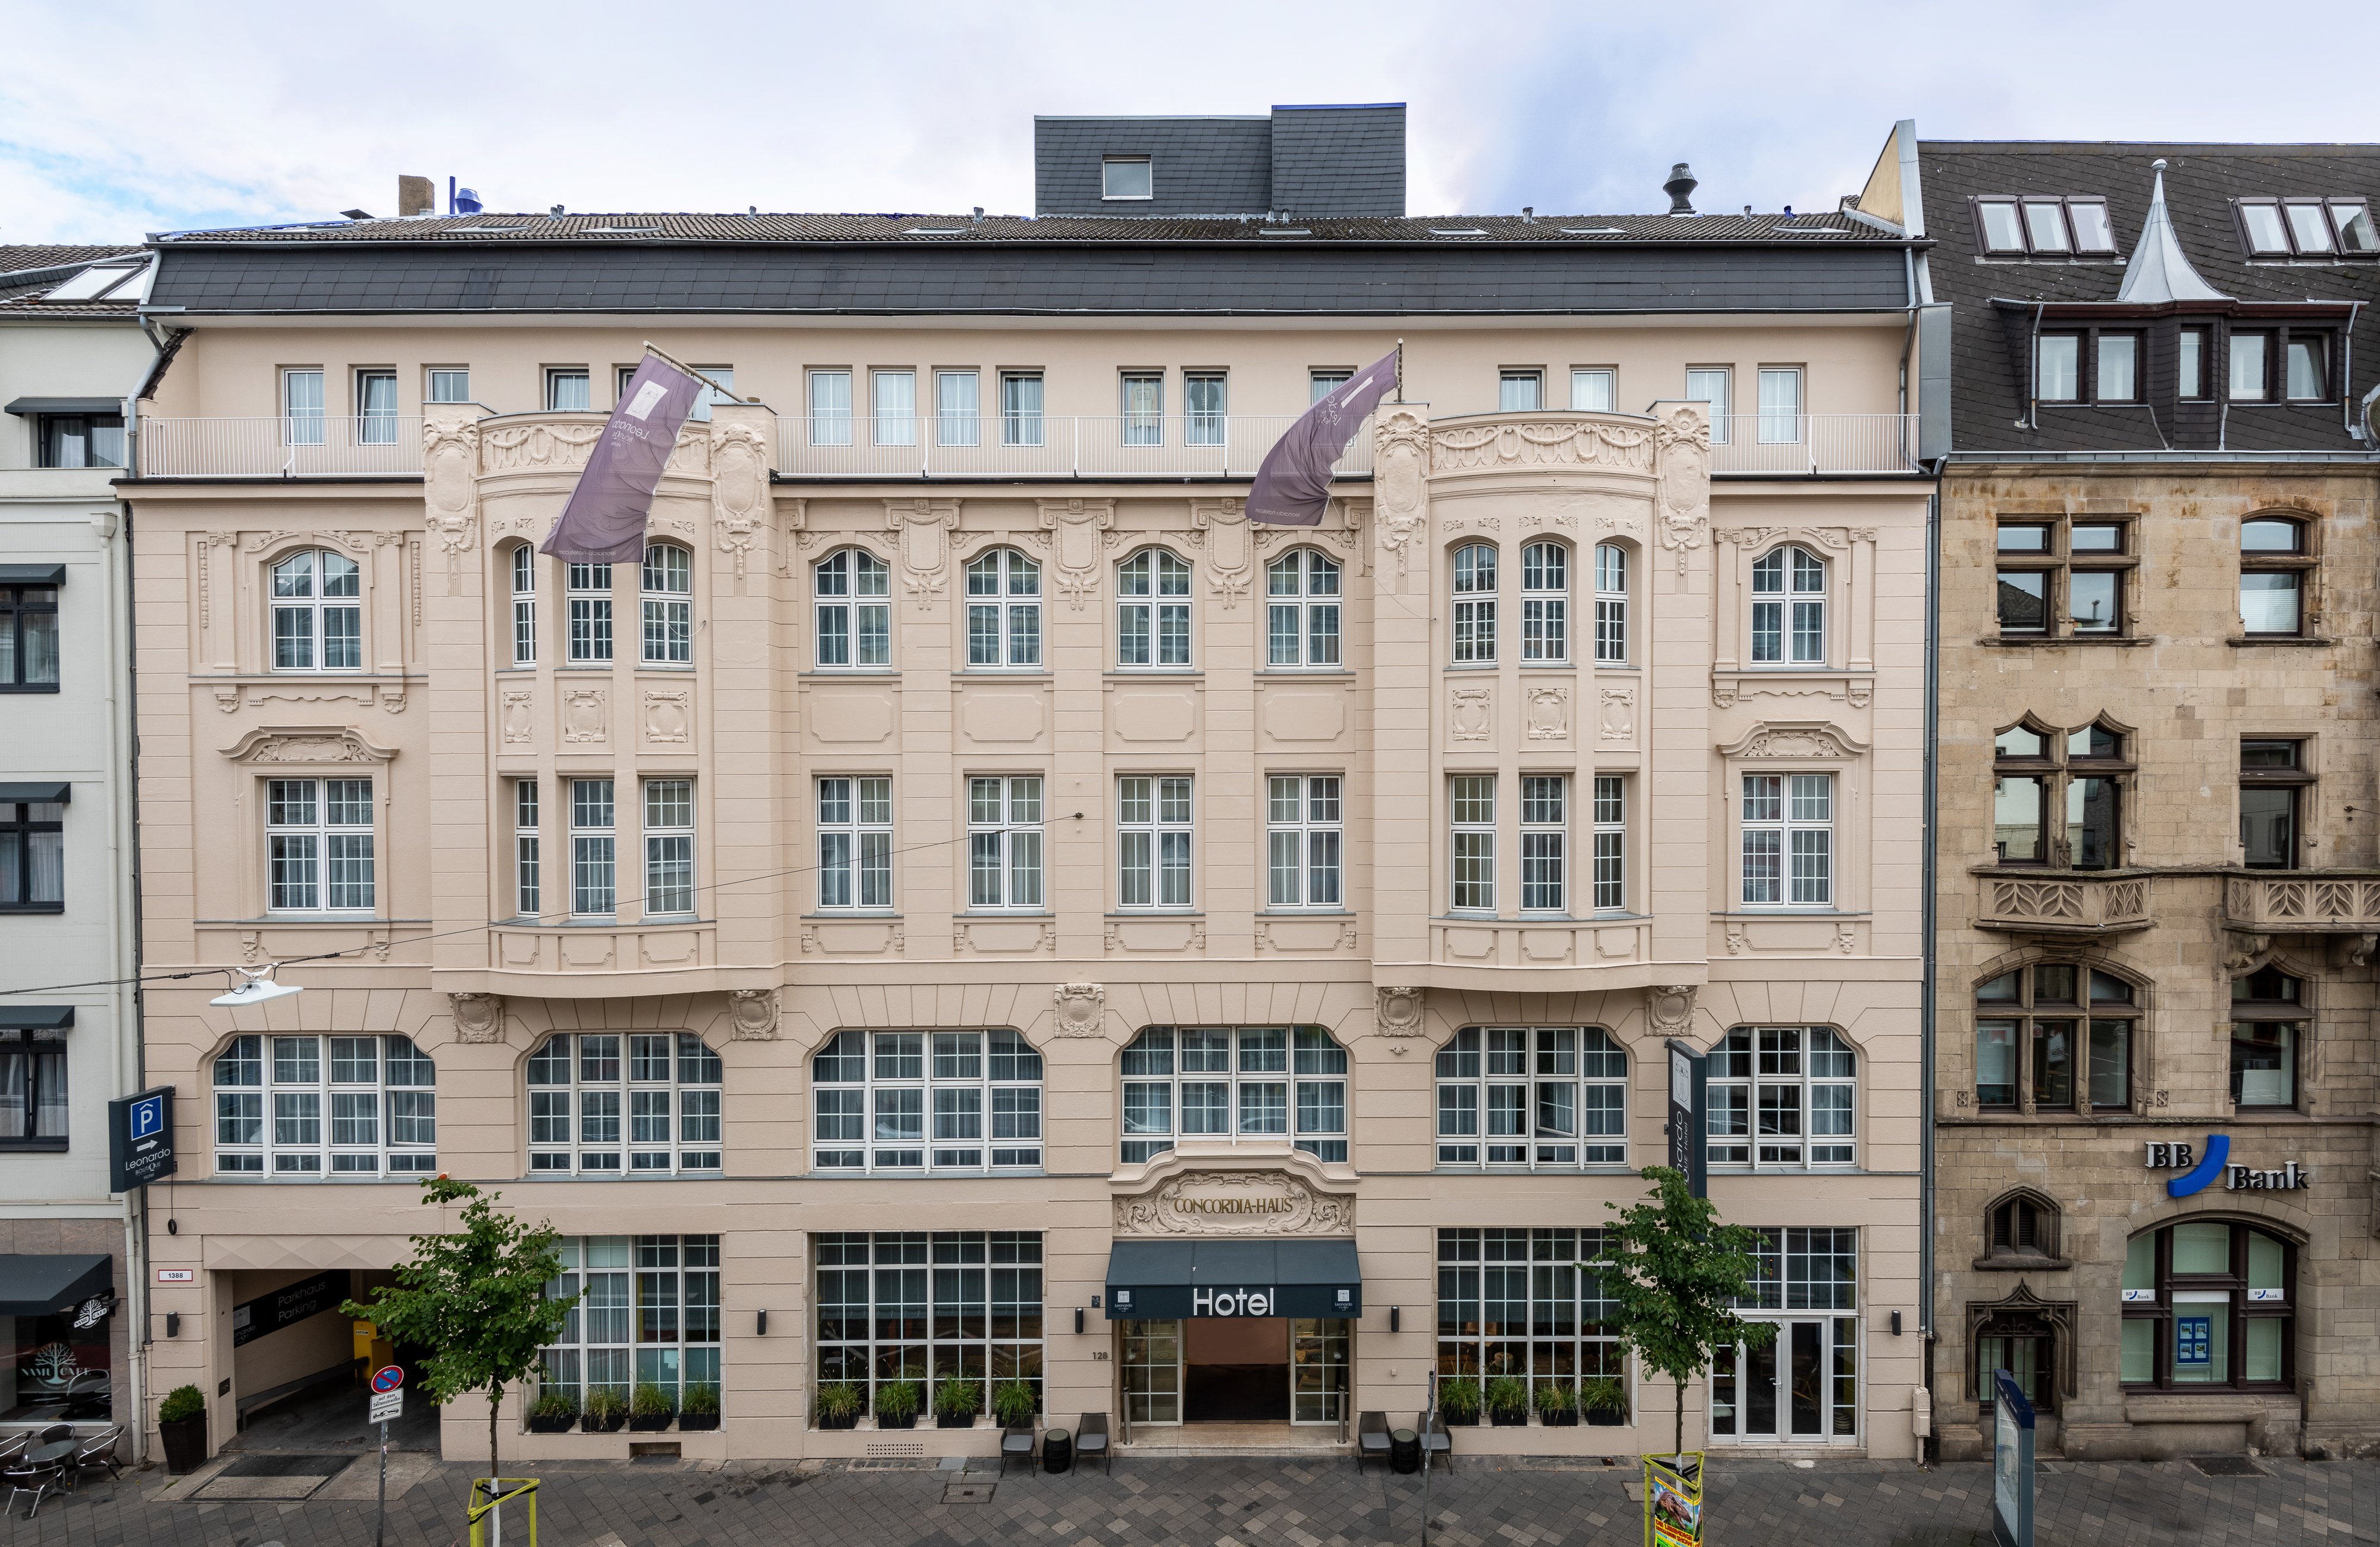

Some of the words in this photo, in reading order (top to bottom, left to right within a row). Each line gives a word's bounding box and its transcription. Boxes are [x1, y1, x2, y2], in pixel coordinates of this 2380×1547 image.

[141, 1110, 153, 1133] P
[126, 1148, 171, 1171] Leonardo
[135, 1161, 161, 1175] BOUTIQUE
[2145, 1141, 2193, 1168] BB
[2225, 1160, 2310, 1189] Bank
[1174, 1197, 1293, 1214] CONCORDIA-HAUS
[278, 1282, 325, 1307] Parkhaus
[1194, 1288, 1274, 1316] Hotel
[93, 1308, 107, 1317] CAFE
[278, 1299, 317, 1322] Parking
[21, 1368, 52, 1376] NAMU
[60, 1368, 91, 1376] CAFE
[373, 1396, 400, 1407] Seitenstreifen
